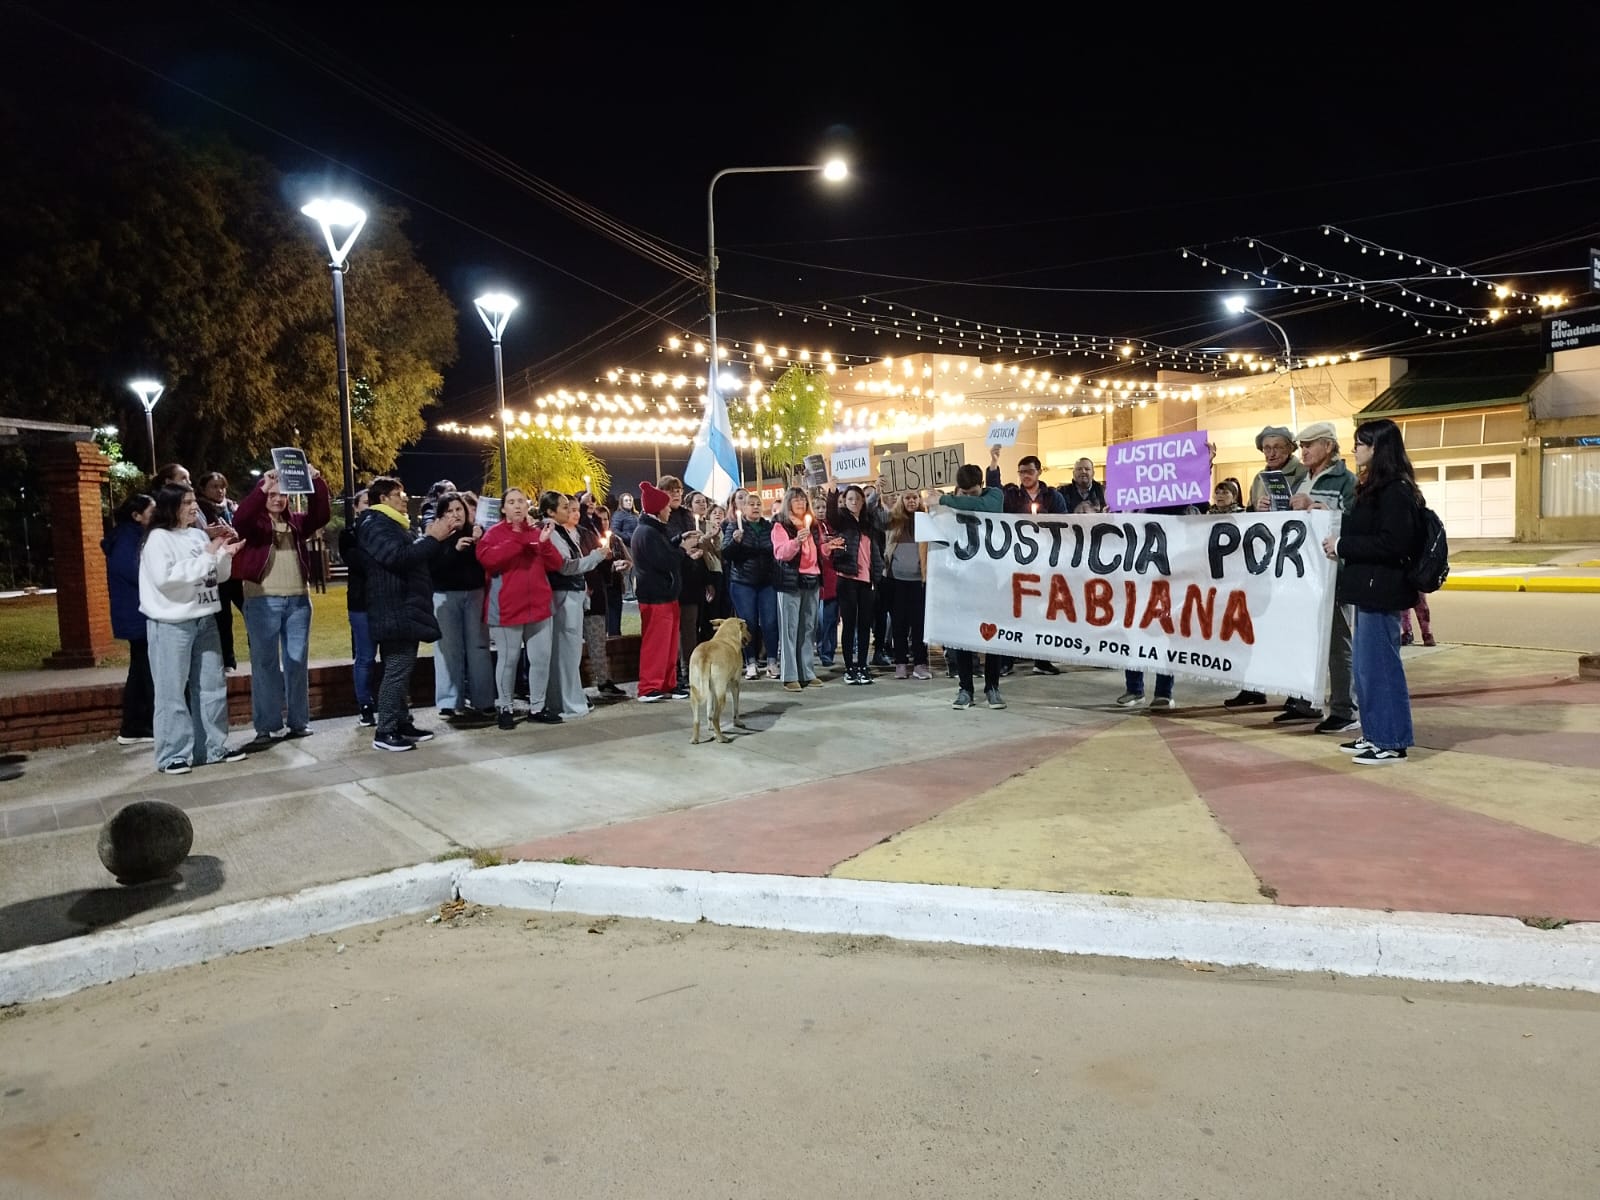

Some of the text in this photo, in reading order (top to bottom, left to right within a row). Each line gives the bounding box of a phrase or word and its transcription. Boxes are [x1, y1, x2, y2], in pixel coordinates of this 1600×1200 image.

[1551, 323, 1600, 339] Rivadavia
[989, 427, 1015, 439] JUSTICIA
[835, 456, 867, 472] JUSTICIA
[1115, 438, 1198, 465] JUSTICIA
[880, 448, 961, 495] JUSTICIA
[1136, 462, 1178, 483] POR
[1116, 480, 1204, 506] FABIANA
[954, 513, 1307, 579] JUSTICIA POR
[1012, 572, 1255, 645] FABIANA
[997, 628, 1232, 672] POR TODOS, POR LA VERDAD
